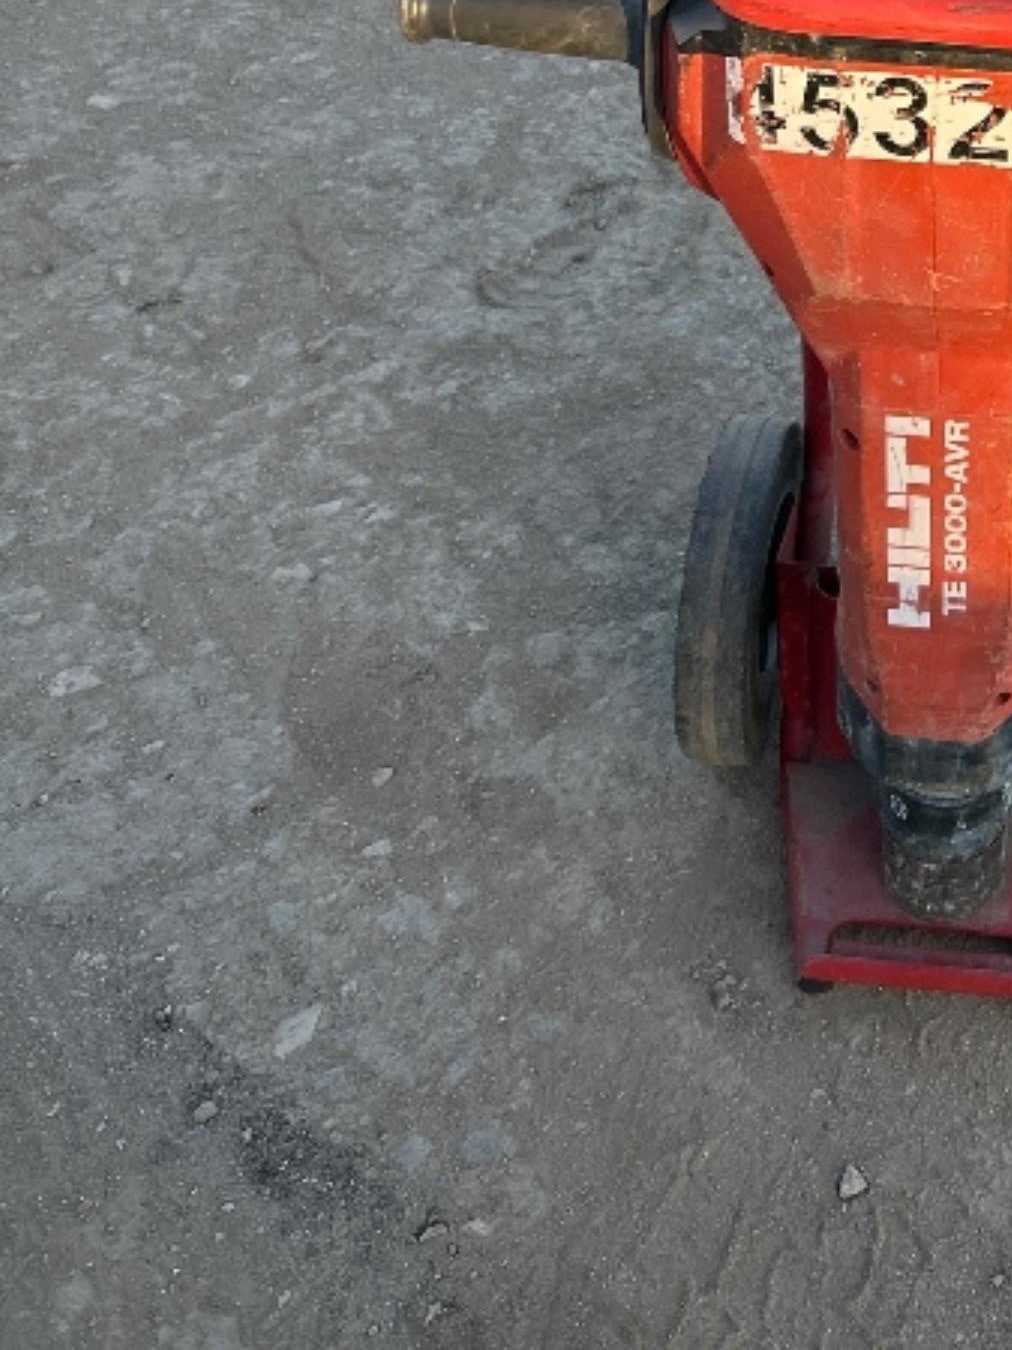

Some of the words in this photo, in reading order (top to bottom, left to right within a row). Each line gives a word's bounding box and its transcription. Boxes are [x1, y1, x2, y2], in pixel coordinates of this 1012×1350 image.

[884, 416, 931, 628] HILTI
[944, 419, 970, 574] 3000-AVR
[942, 581, 967, 616] TE
